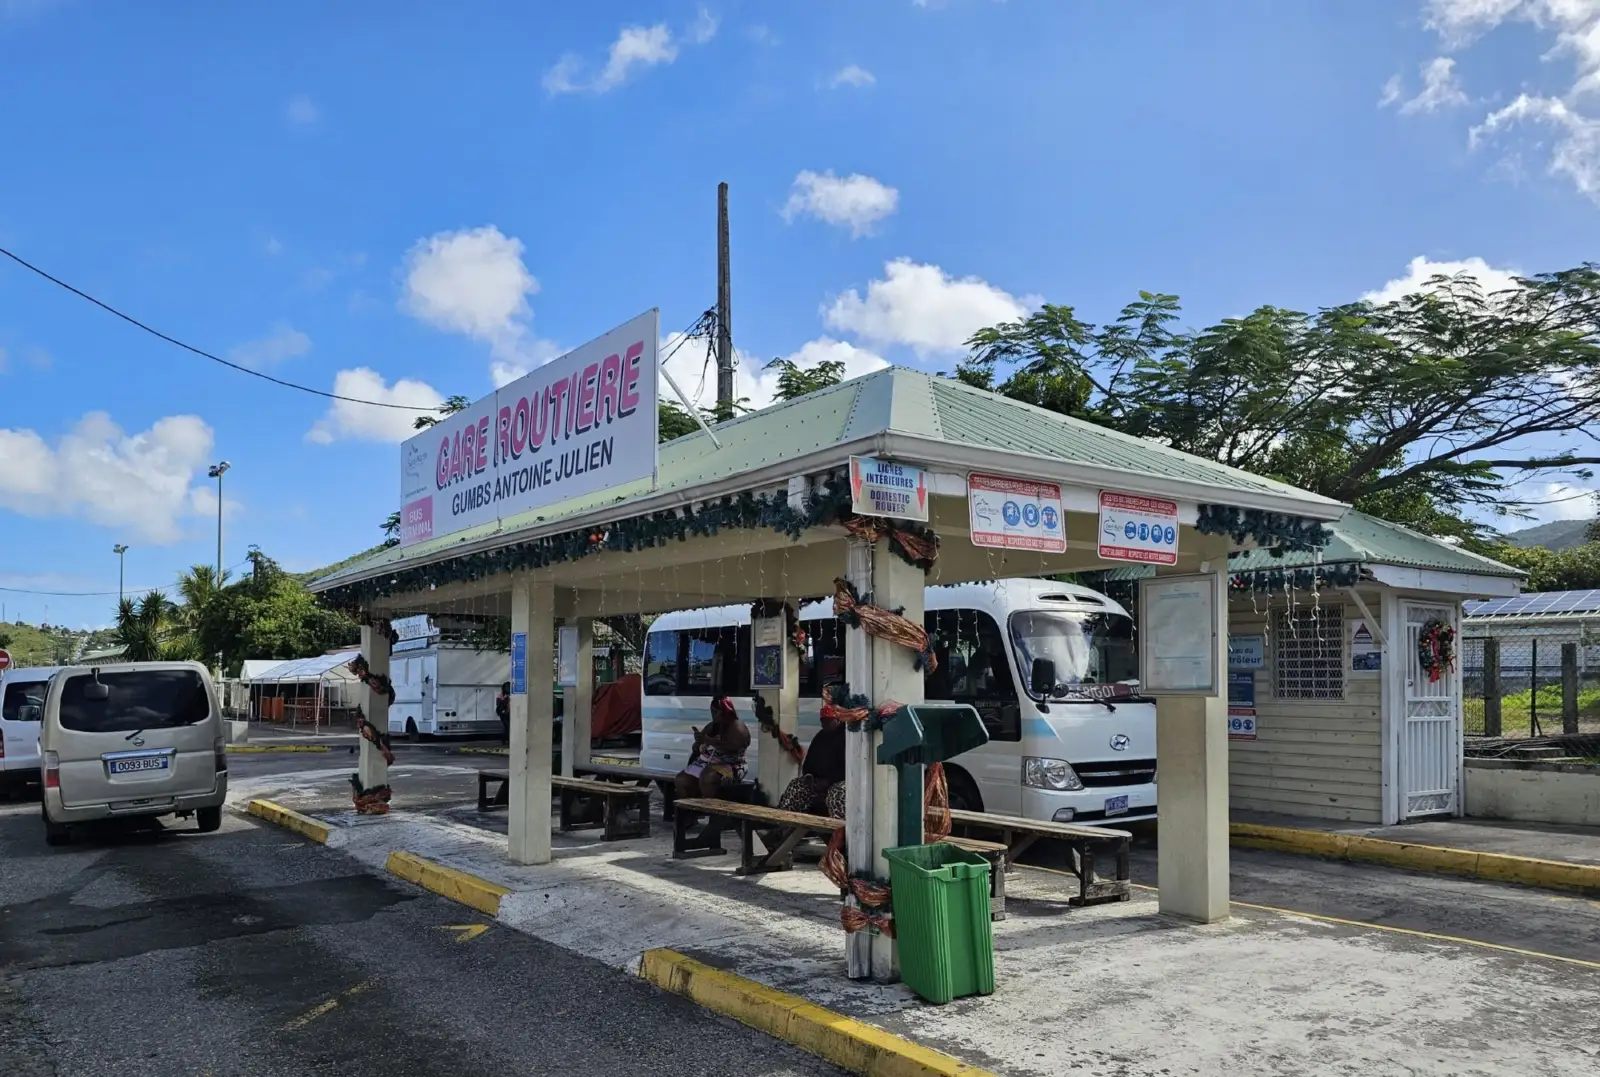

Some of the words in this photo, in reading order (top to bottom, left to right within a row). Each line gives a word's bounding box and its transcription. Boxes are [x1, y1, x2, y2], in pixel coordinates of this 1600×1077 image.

[436, 415, 490, 491] GARE
[493, 340, 644, 468] ROUTIERE
[452, 484, 491, 516] GUMBS
[493, 458, 552, 503] ANTOINE
[555, 436, 614, 482] JULIEN
[866, 472, 914, 488] INTÉRIEURES
[870, 490, 910, 504] DOMESTIC
[875, 501, 906, 513] ROUTES
[409, 507, 423, 524] BUS
[1229, 655, 1262, 664] trôleur
